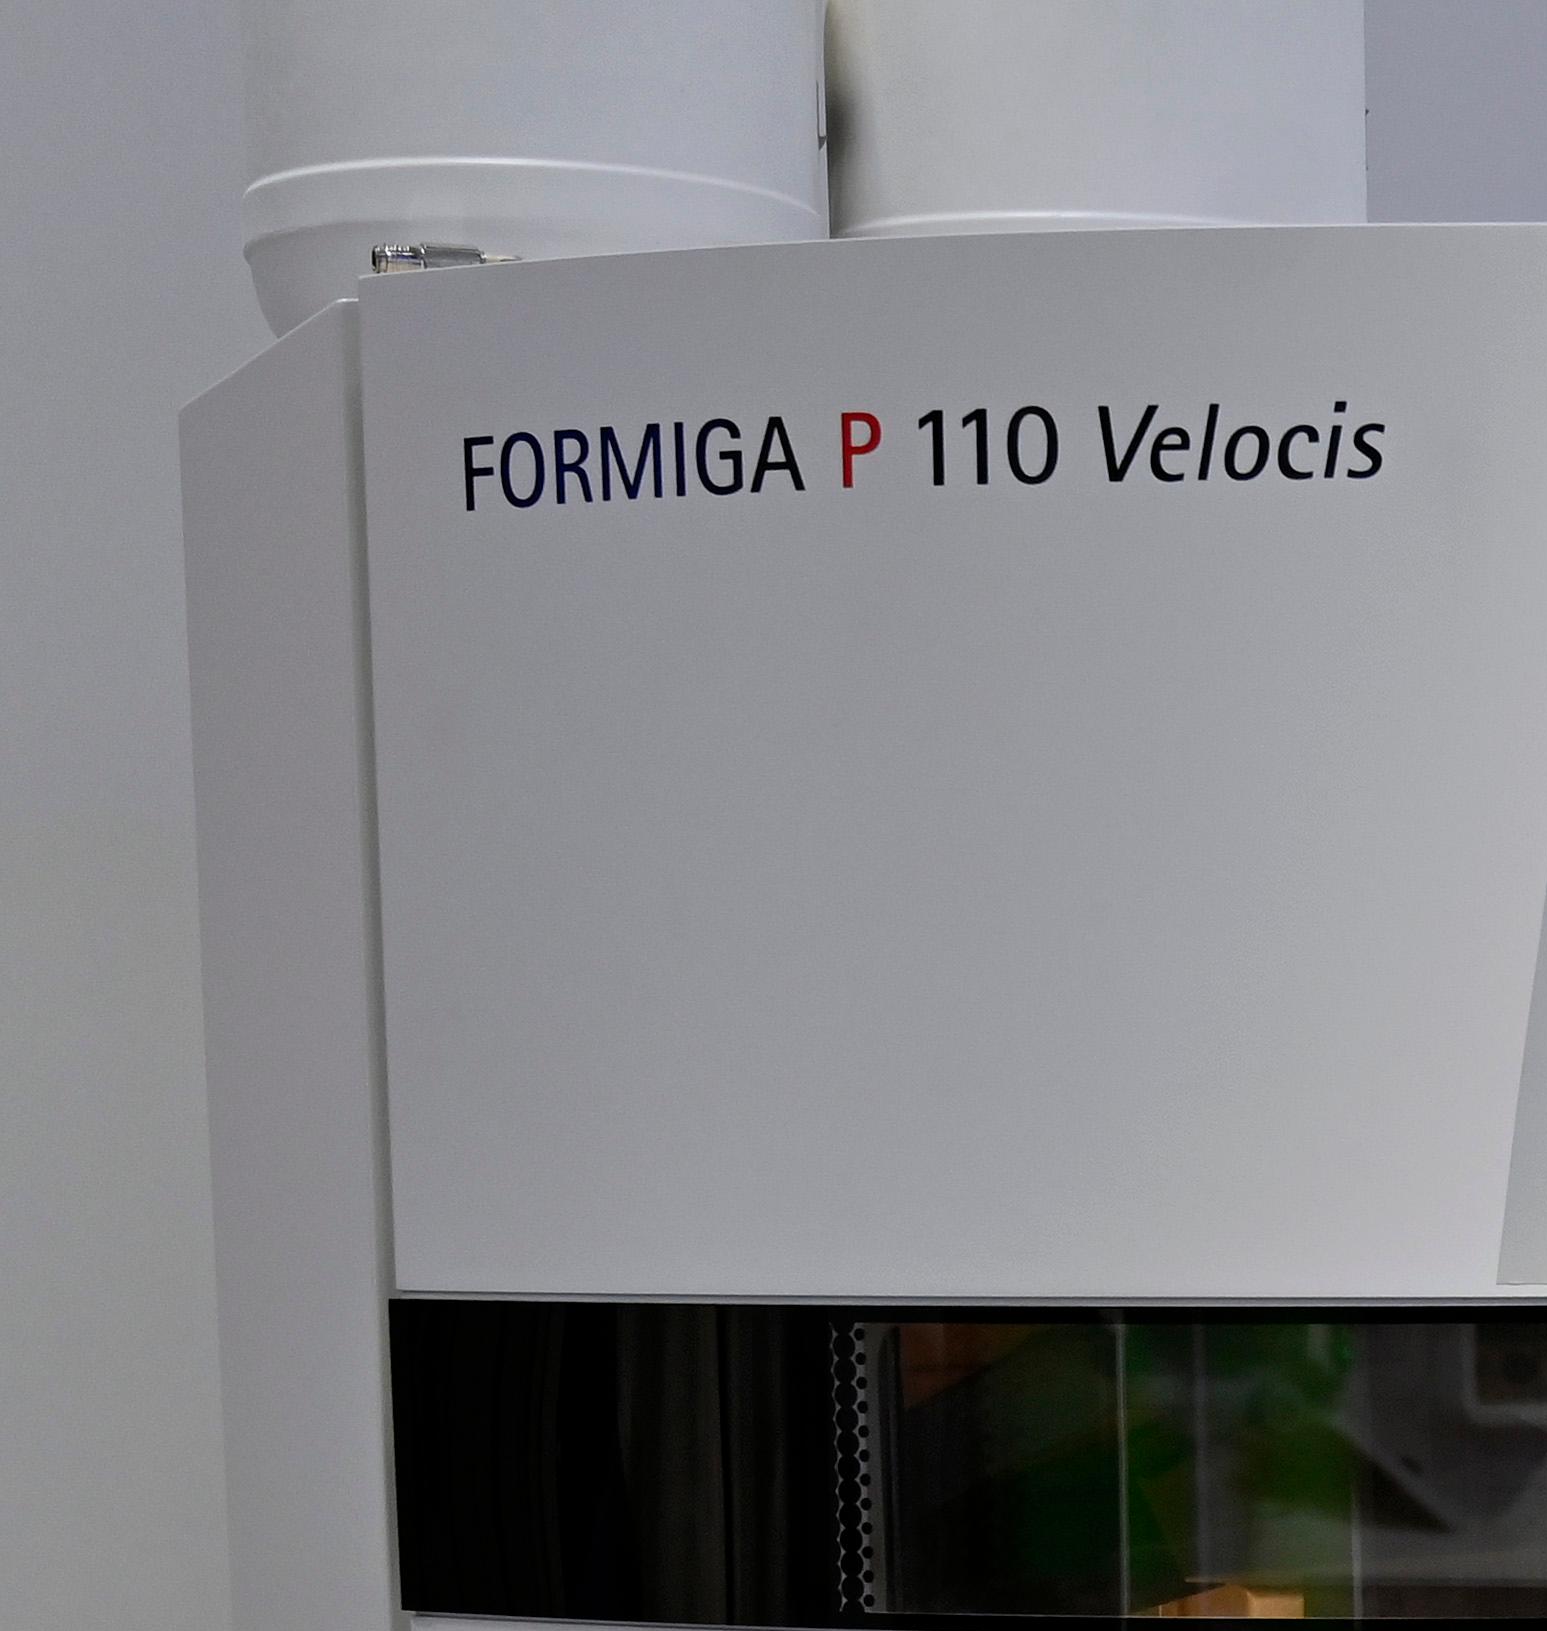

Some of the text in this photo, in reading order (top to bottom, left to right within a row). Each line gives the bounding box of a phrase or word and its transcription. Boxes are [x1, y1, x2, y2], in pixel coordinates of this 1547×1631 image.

[463, 400, 1386, 512] FORMIGA P 110 Velocis
